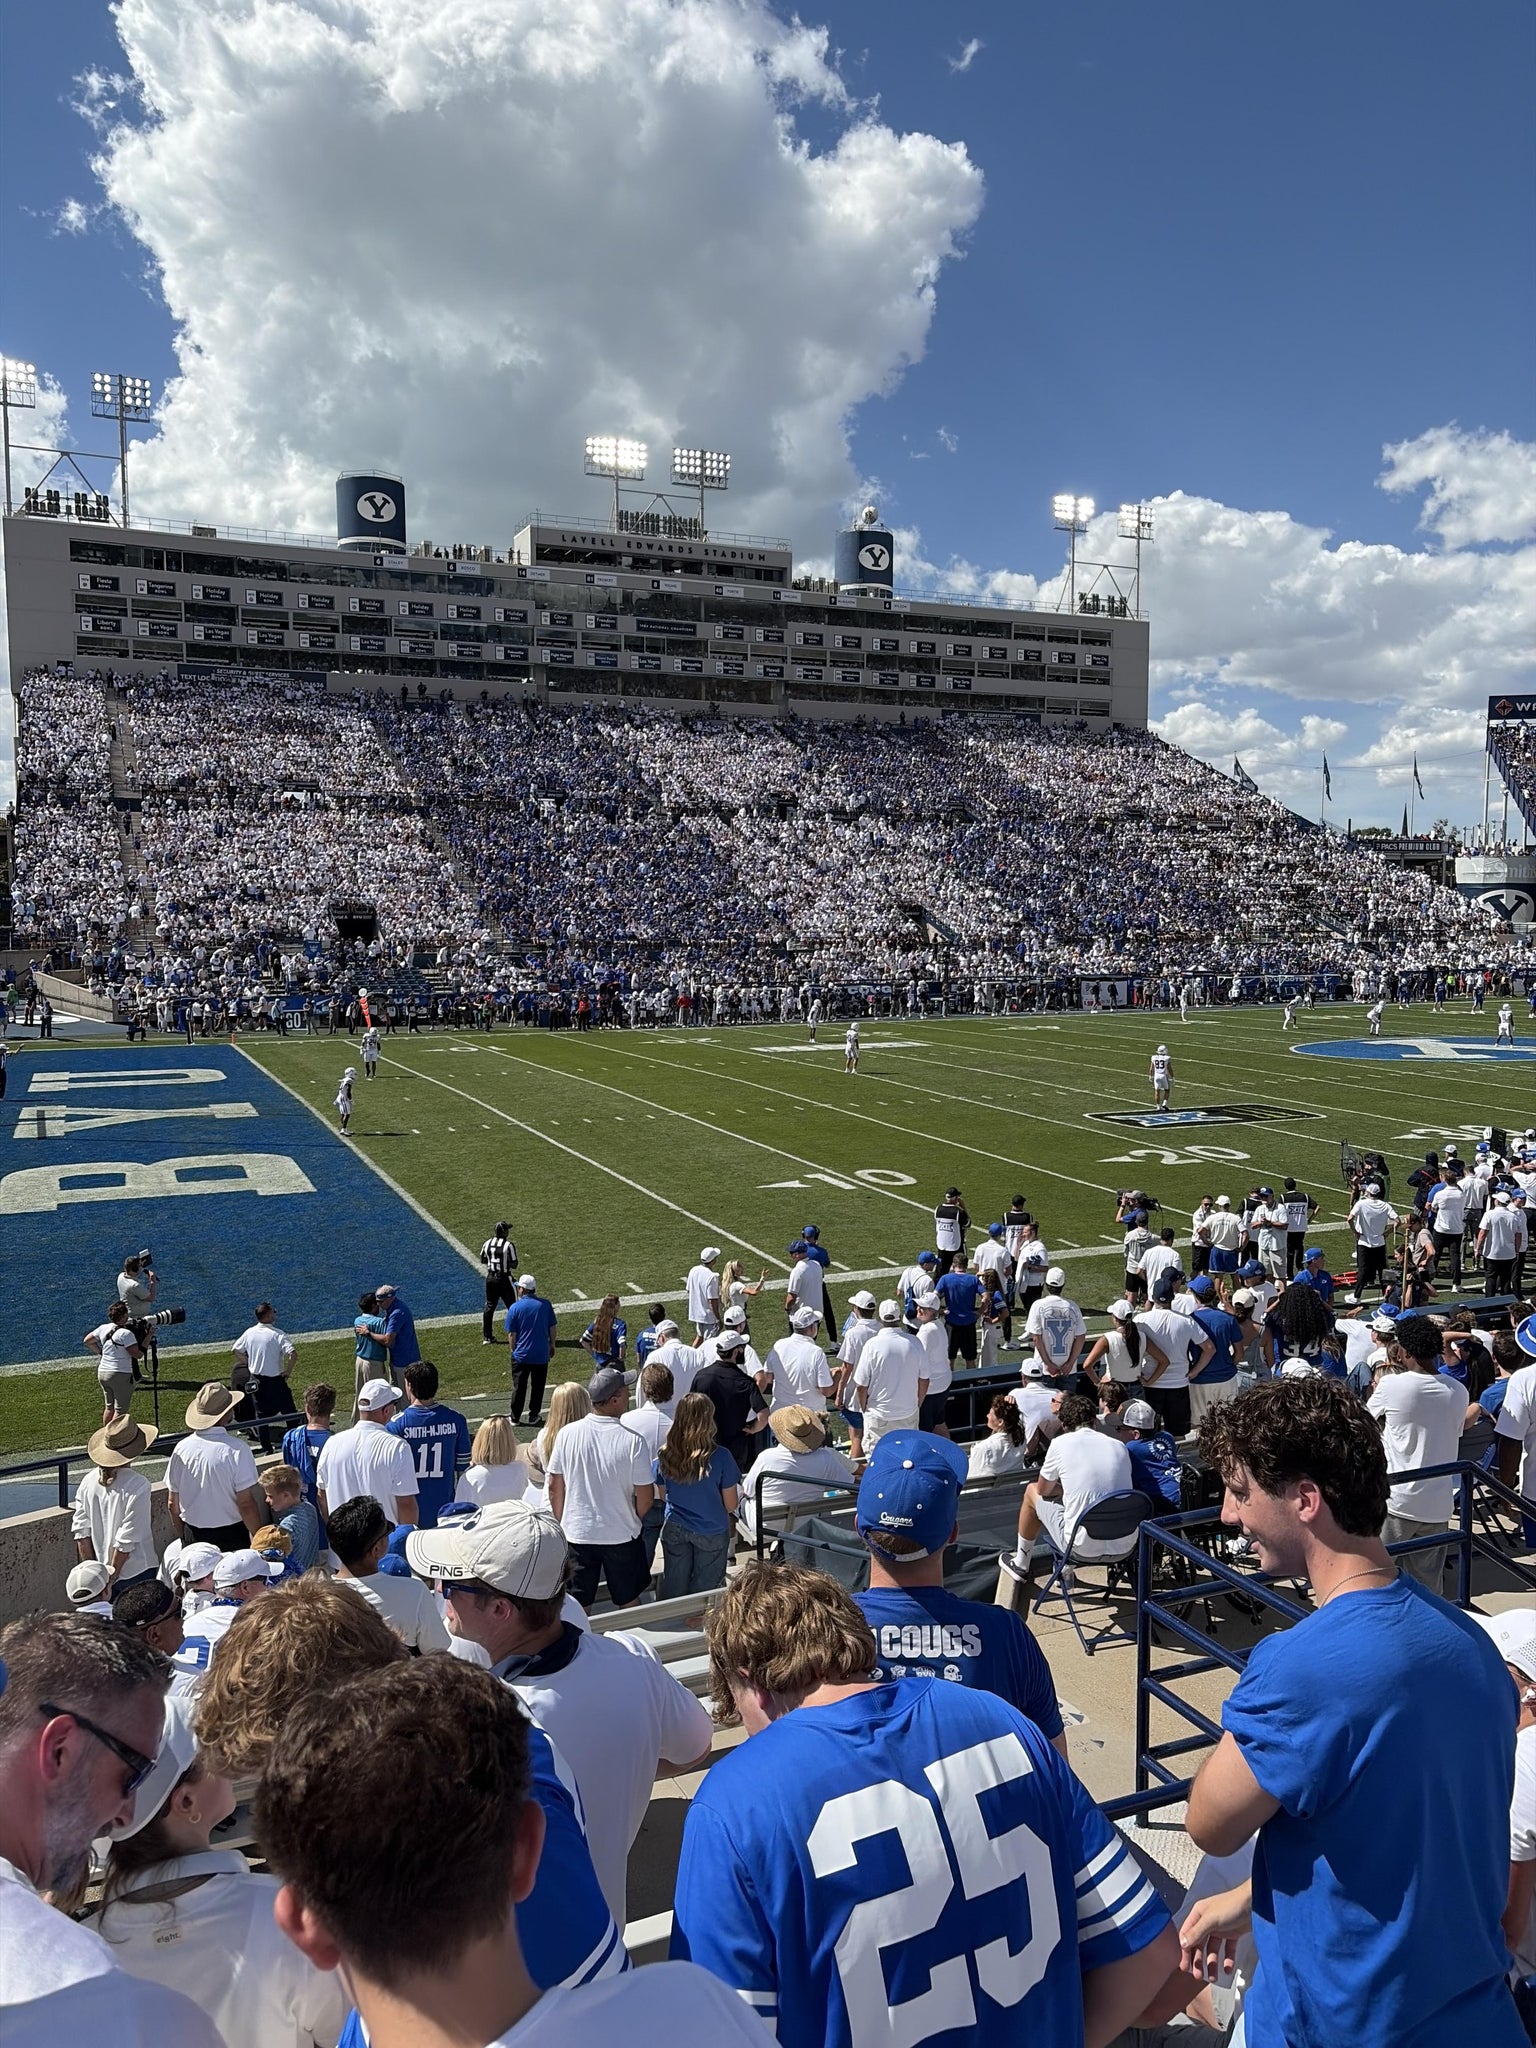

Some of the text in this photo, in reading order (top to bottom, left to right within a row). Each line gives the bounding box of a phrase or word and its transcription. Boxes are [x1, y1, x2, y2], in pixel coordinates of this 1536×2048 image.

[364, 495, 390, 519] Y
[561, 534, 767, 561] LAVELL EDWARDS STADIUM
[865, 547, 886, 567] Y
[216, 668, 242, 676] SECURITY
[1399, 843, 1424, 851] PREMIUM
[1425, 843, 1440, 851] CLUB
[0, 1068, 317, 1214] BYU
[1127, 1145, 1251, 1165] 20
[804, 1169, 917, 1190] 10
[1045, 1319, 1073, 1356] Y
[404, 1422, 457, 1439] SMITH-NJIGBA
[416, 1442, 444, 1478] 11
[429, 1565, 463, 1577] PING
[880, 1624, 982, 1659] COUGS
[807, 1732, 1061, 2048] 25
